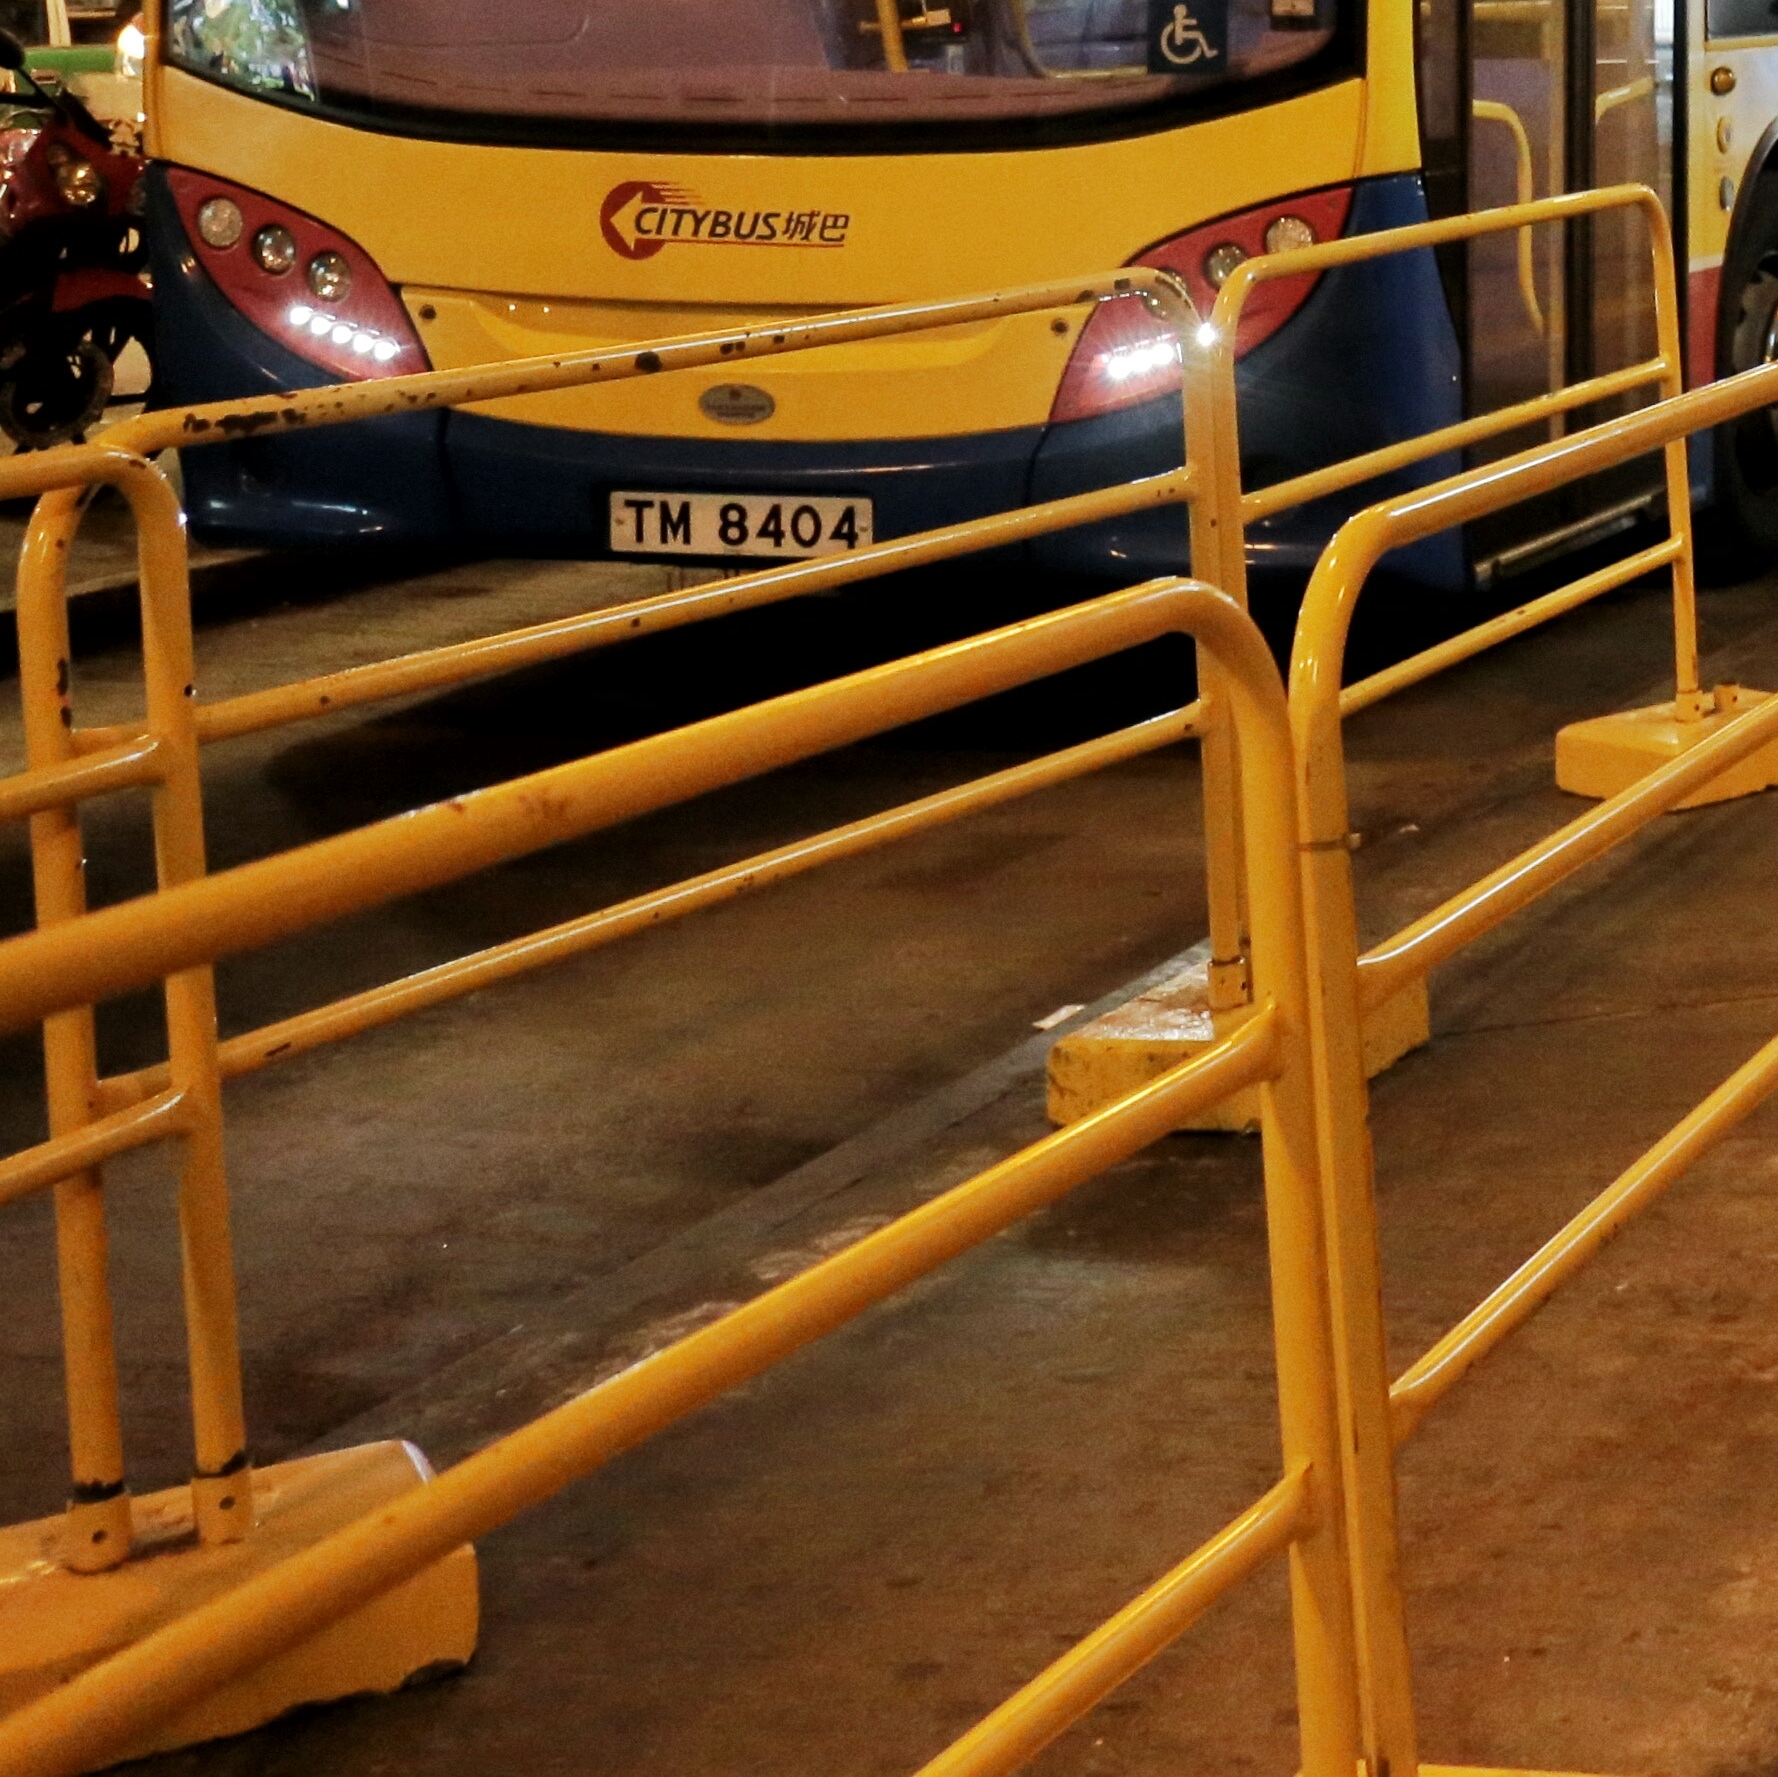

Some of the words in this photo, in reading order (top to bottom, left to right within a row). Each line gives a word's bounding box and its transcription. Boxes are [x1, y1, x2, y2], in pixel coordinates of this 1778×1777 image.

[634, 206, 780, 240] CITYBUS
[782, 210, 849, 242] 城巴
[624, 499, 691, 545] TM
[718, 503, 859, 550] 8404
